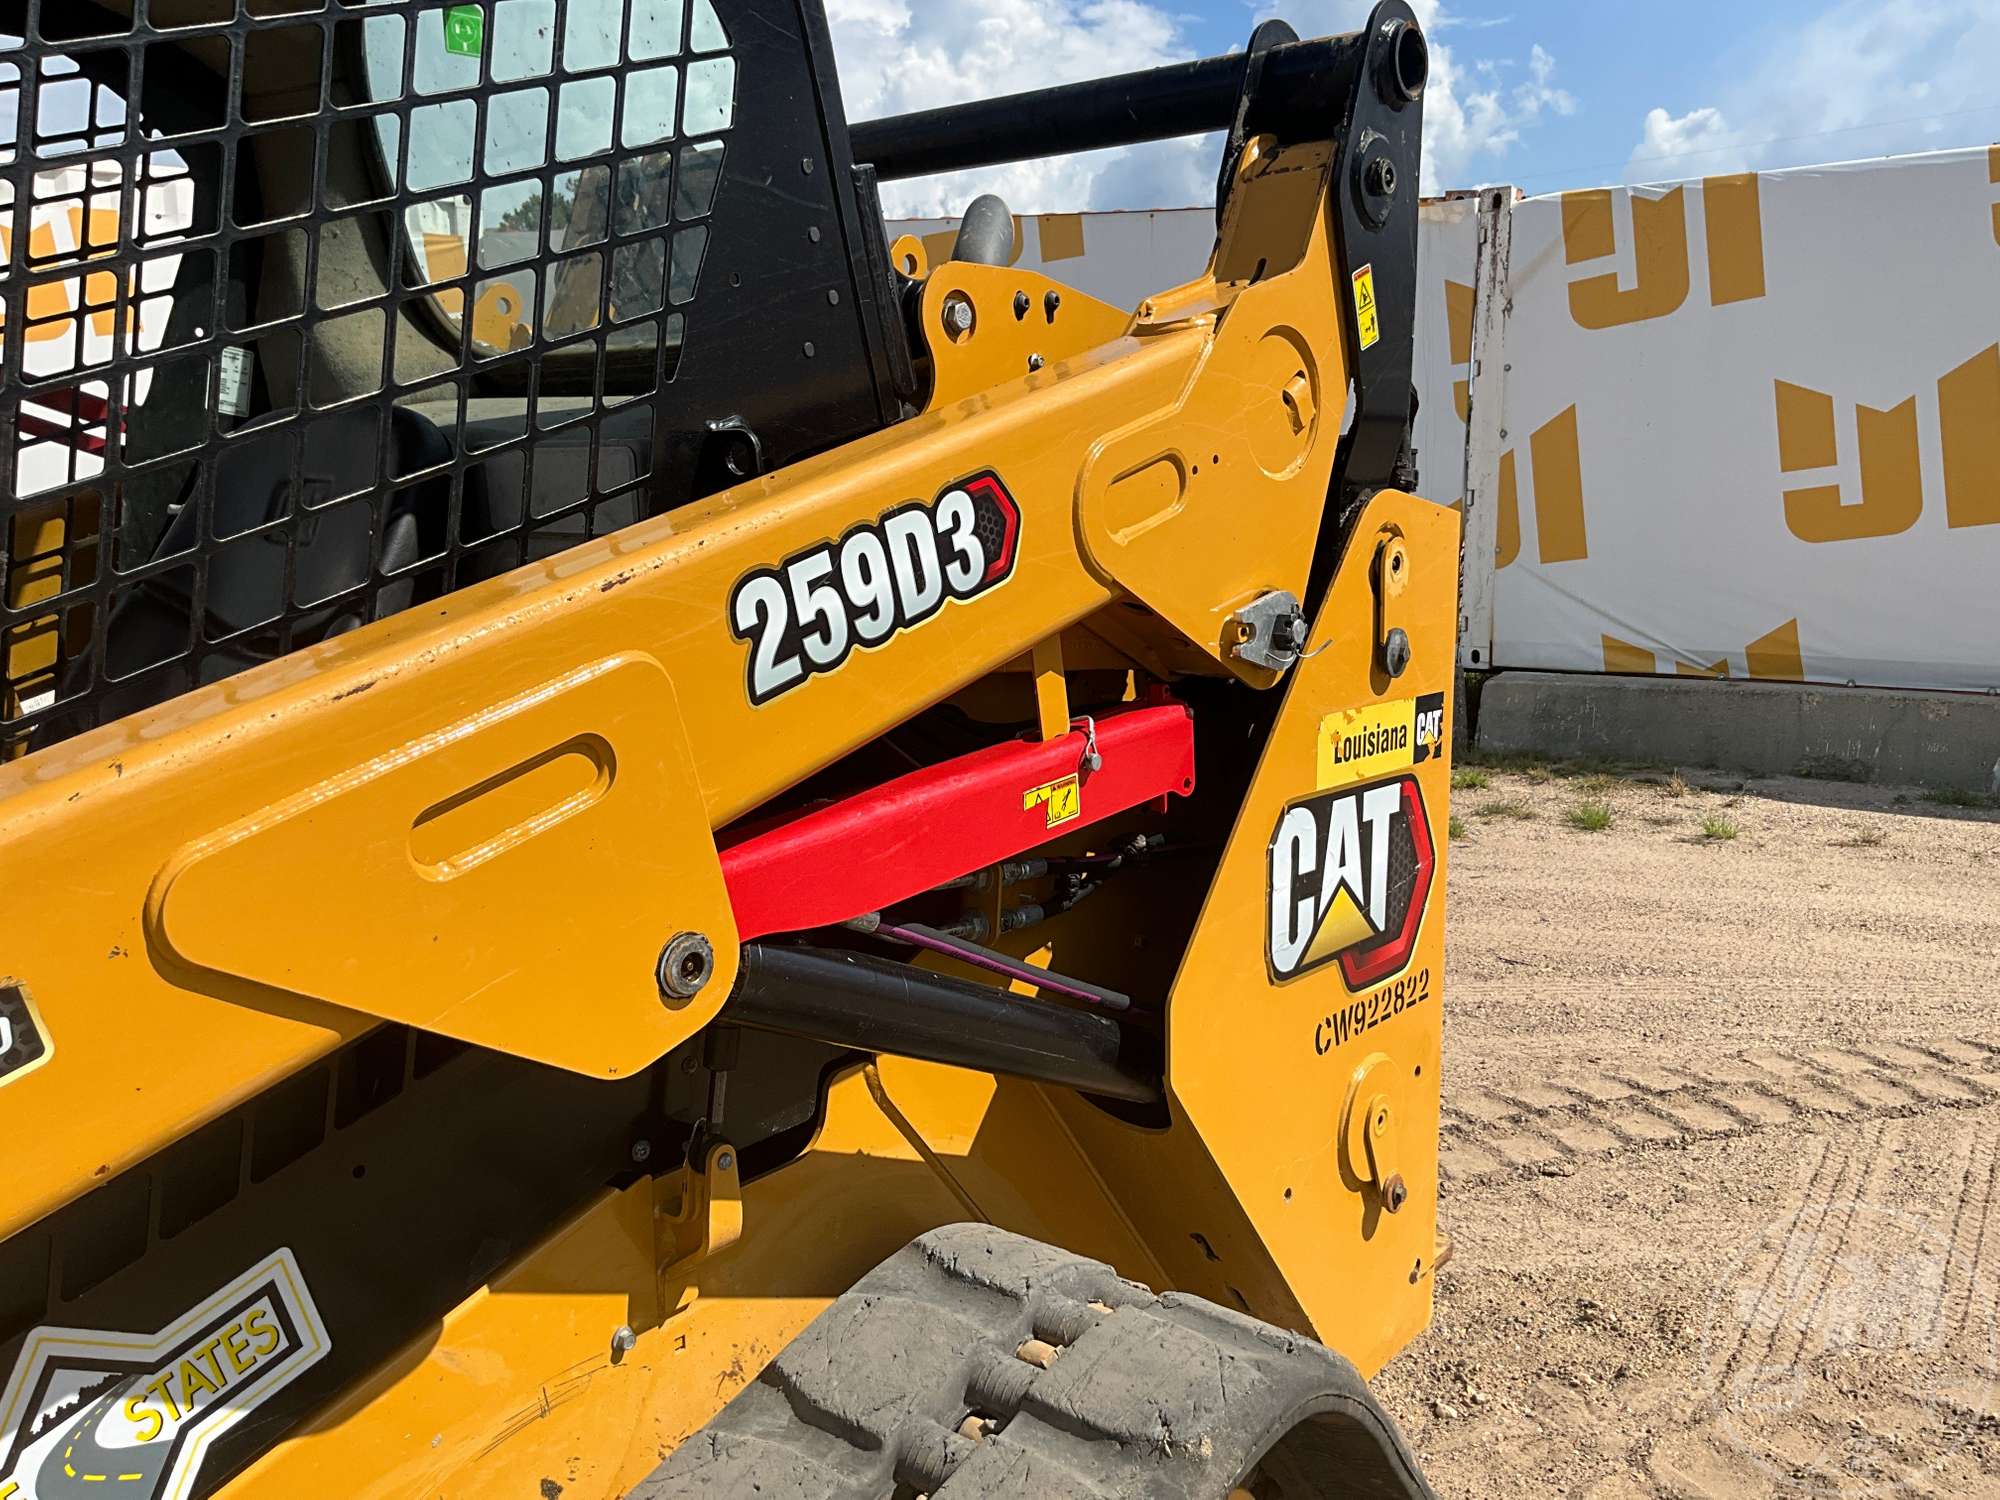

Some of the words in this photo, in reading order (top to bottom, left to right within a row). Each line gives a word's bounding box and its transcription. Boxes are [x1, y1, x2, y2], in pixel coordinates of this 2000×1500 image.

[736, 490, 985, 697] 259D3
[1333, 723, 1407, 764] Louisiana
[1416, 709, 1443, 746] CAT
[1271, 783, 1402, 973] CAT
[1315, 968, 1429, 1055] CW922822
[123, 1309, 281, 1442] STATES
